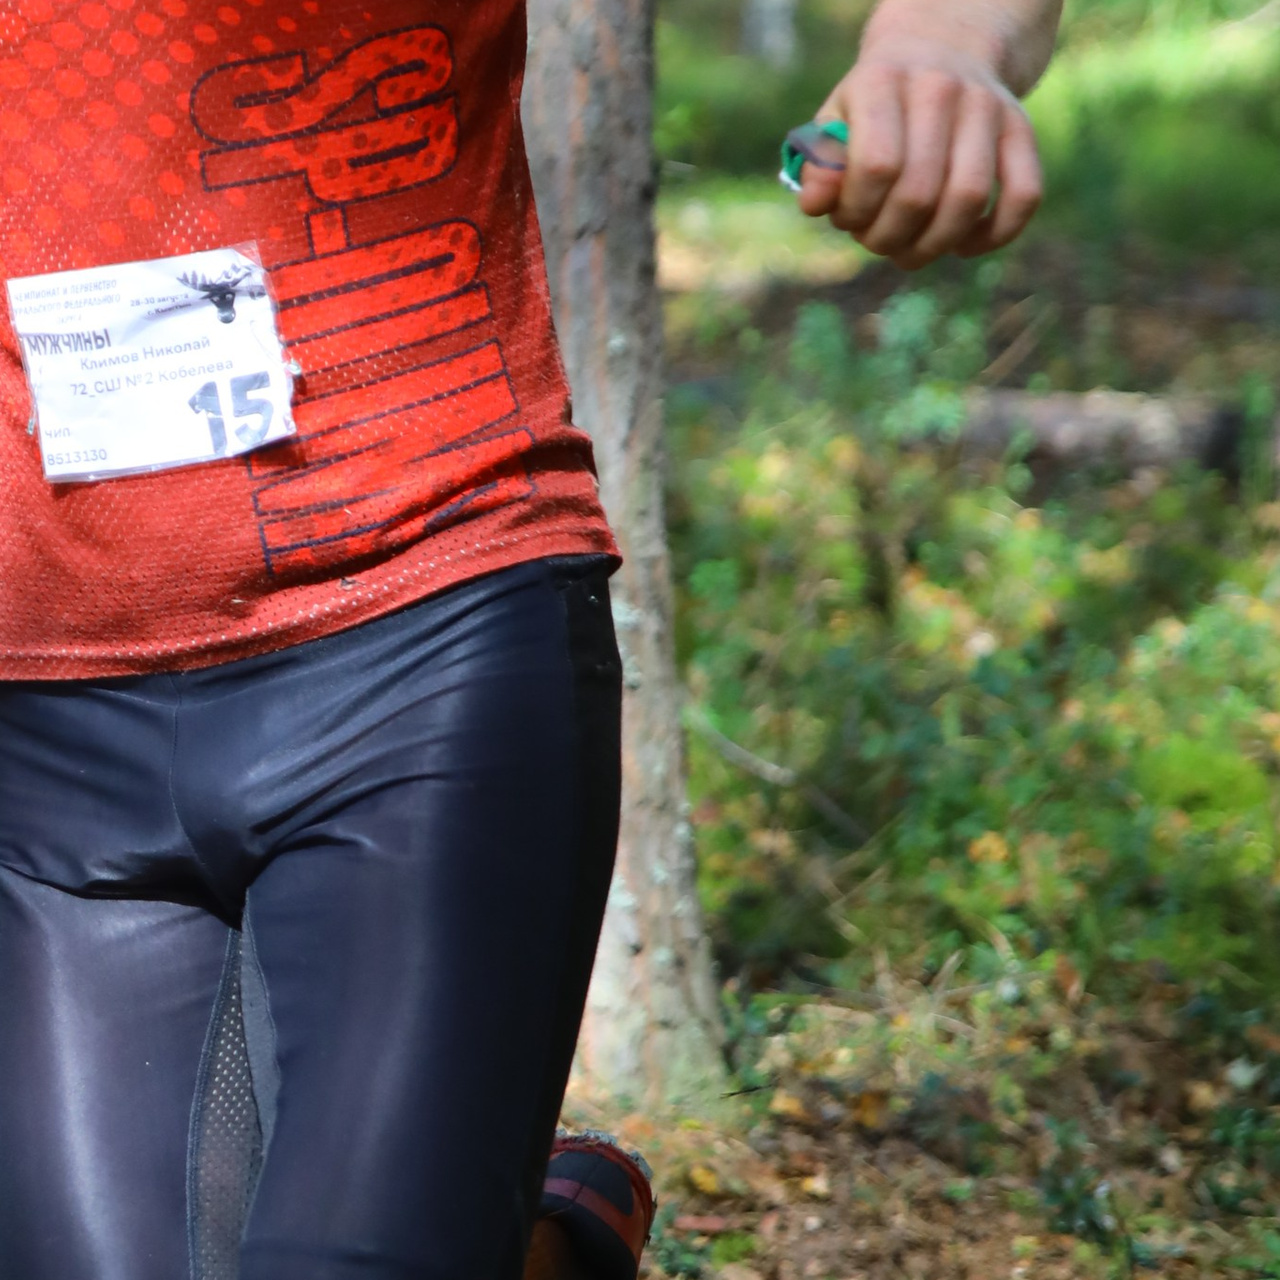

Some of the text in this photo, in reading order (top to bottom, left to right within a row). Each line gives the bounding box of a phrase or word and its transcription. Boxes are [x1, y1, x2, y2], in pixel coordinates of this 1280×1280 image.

[62, 286, 68, 296] И
[70, 279, 117, 295] ПЕРВЕНСТВО
[63, 293, 121, 309] ФЕДЕРАЛЬНОГО
[26, 328, 112, 356] МУЖЧИНЫ
[80, 336, 211, 370] Климов Николай
[158, 360, 234, 382] Кобелева
[188, 371, 274, 457] 15
[47, 448, 108, 466] 8513130
